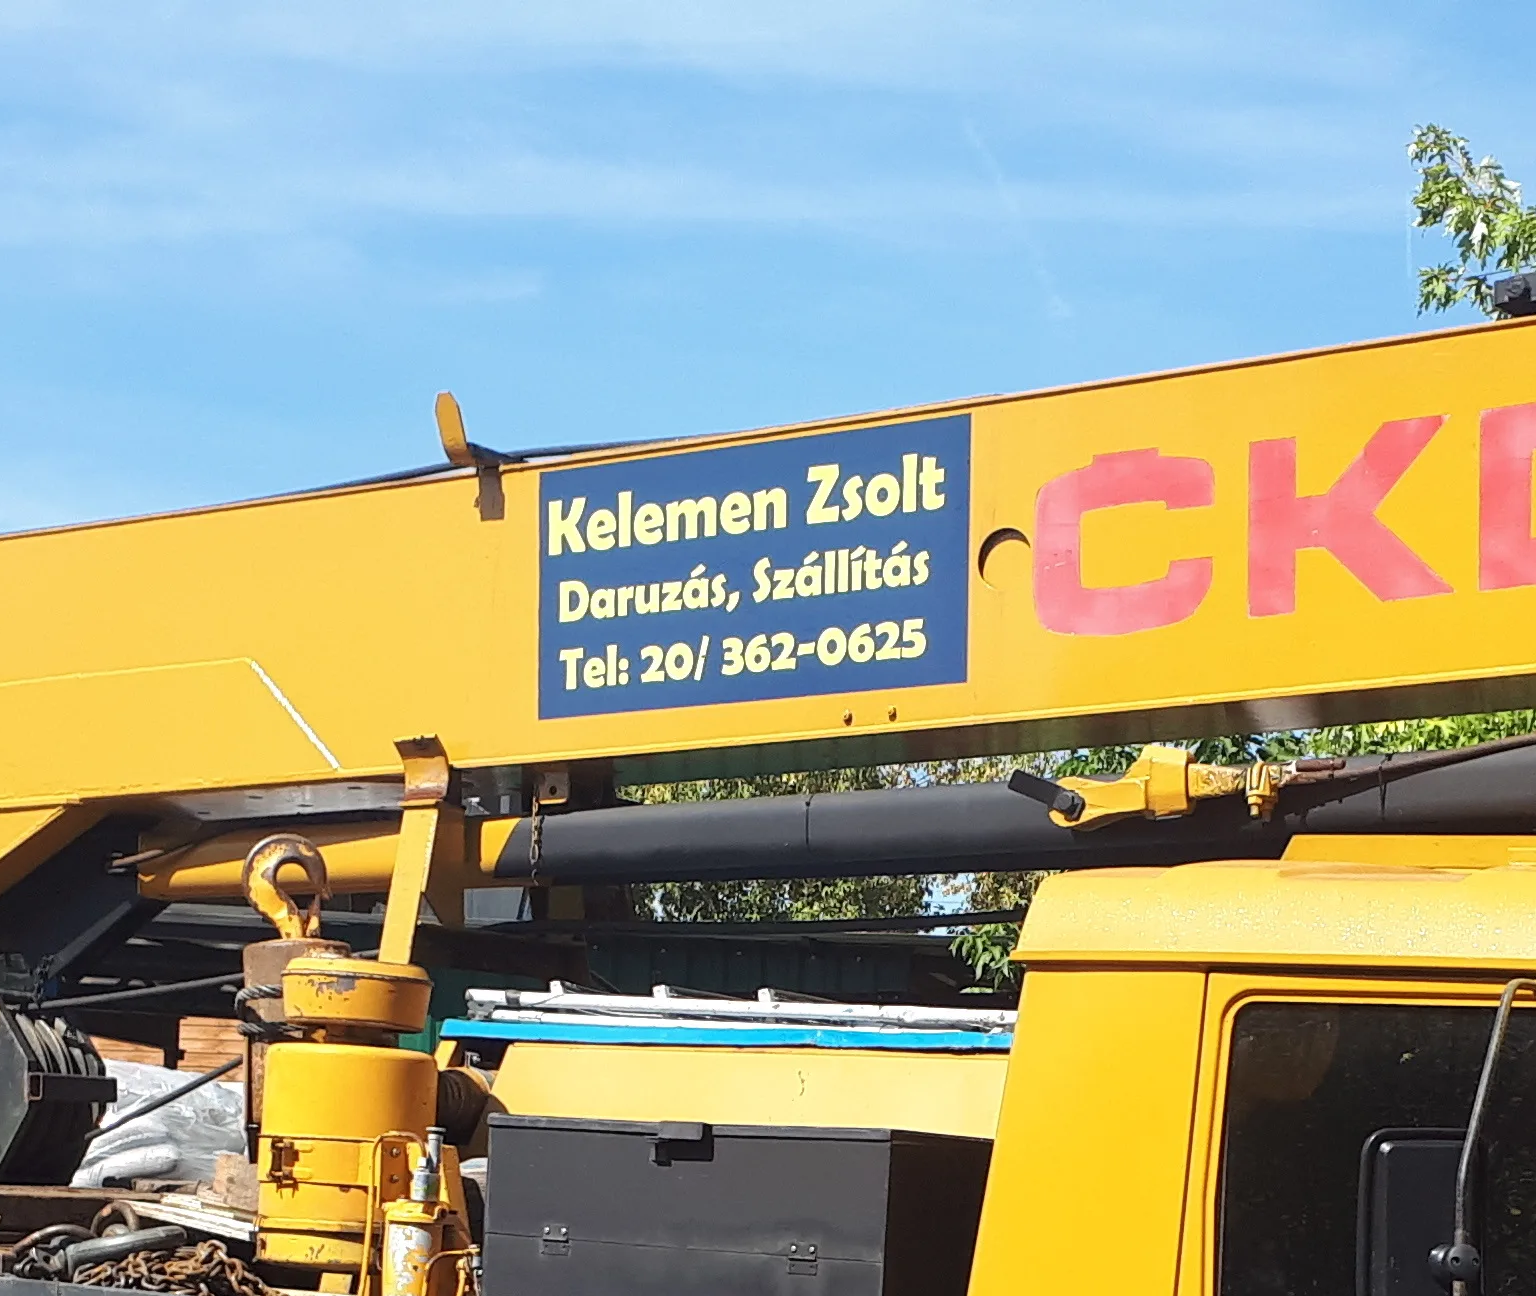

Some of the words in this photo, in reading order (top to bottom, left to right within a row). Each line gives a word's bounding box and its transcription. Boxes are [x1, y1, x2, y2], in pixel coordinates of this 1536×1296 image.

[547, 488, 787, 556] Kelemen
[806, 453, 946, 525] Zsolt
[558, 564, 740, 623] Daruzás,
[752, 540, 930, 603] Szállítás
[559, 645, 629, 691] Tel:
[640, 635, 710, 684] 20/
[721, 618, 927, 676] 362-0625
